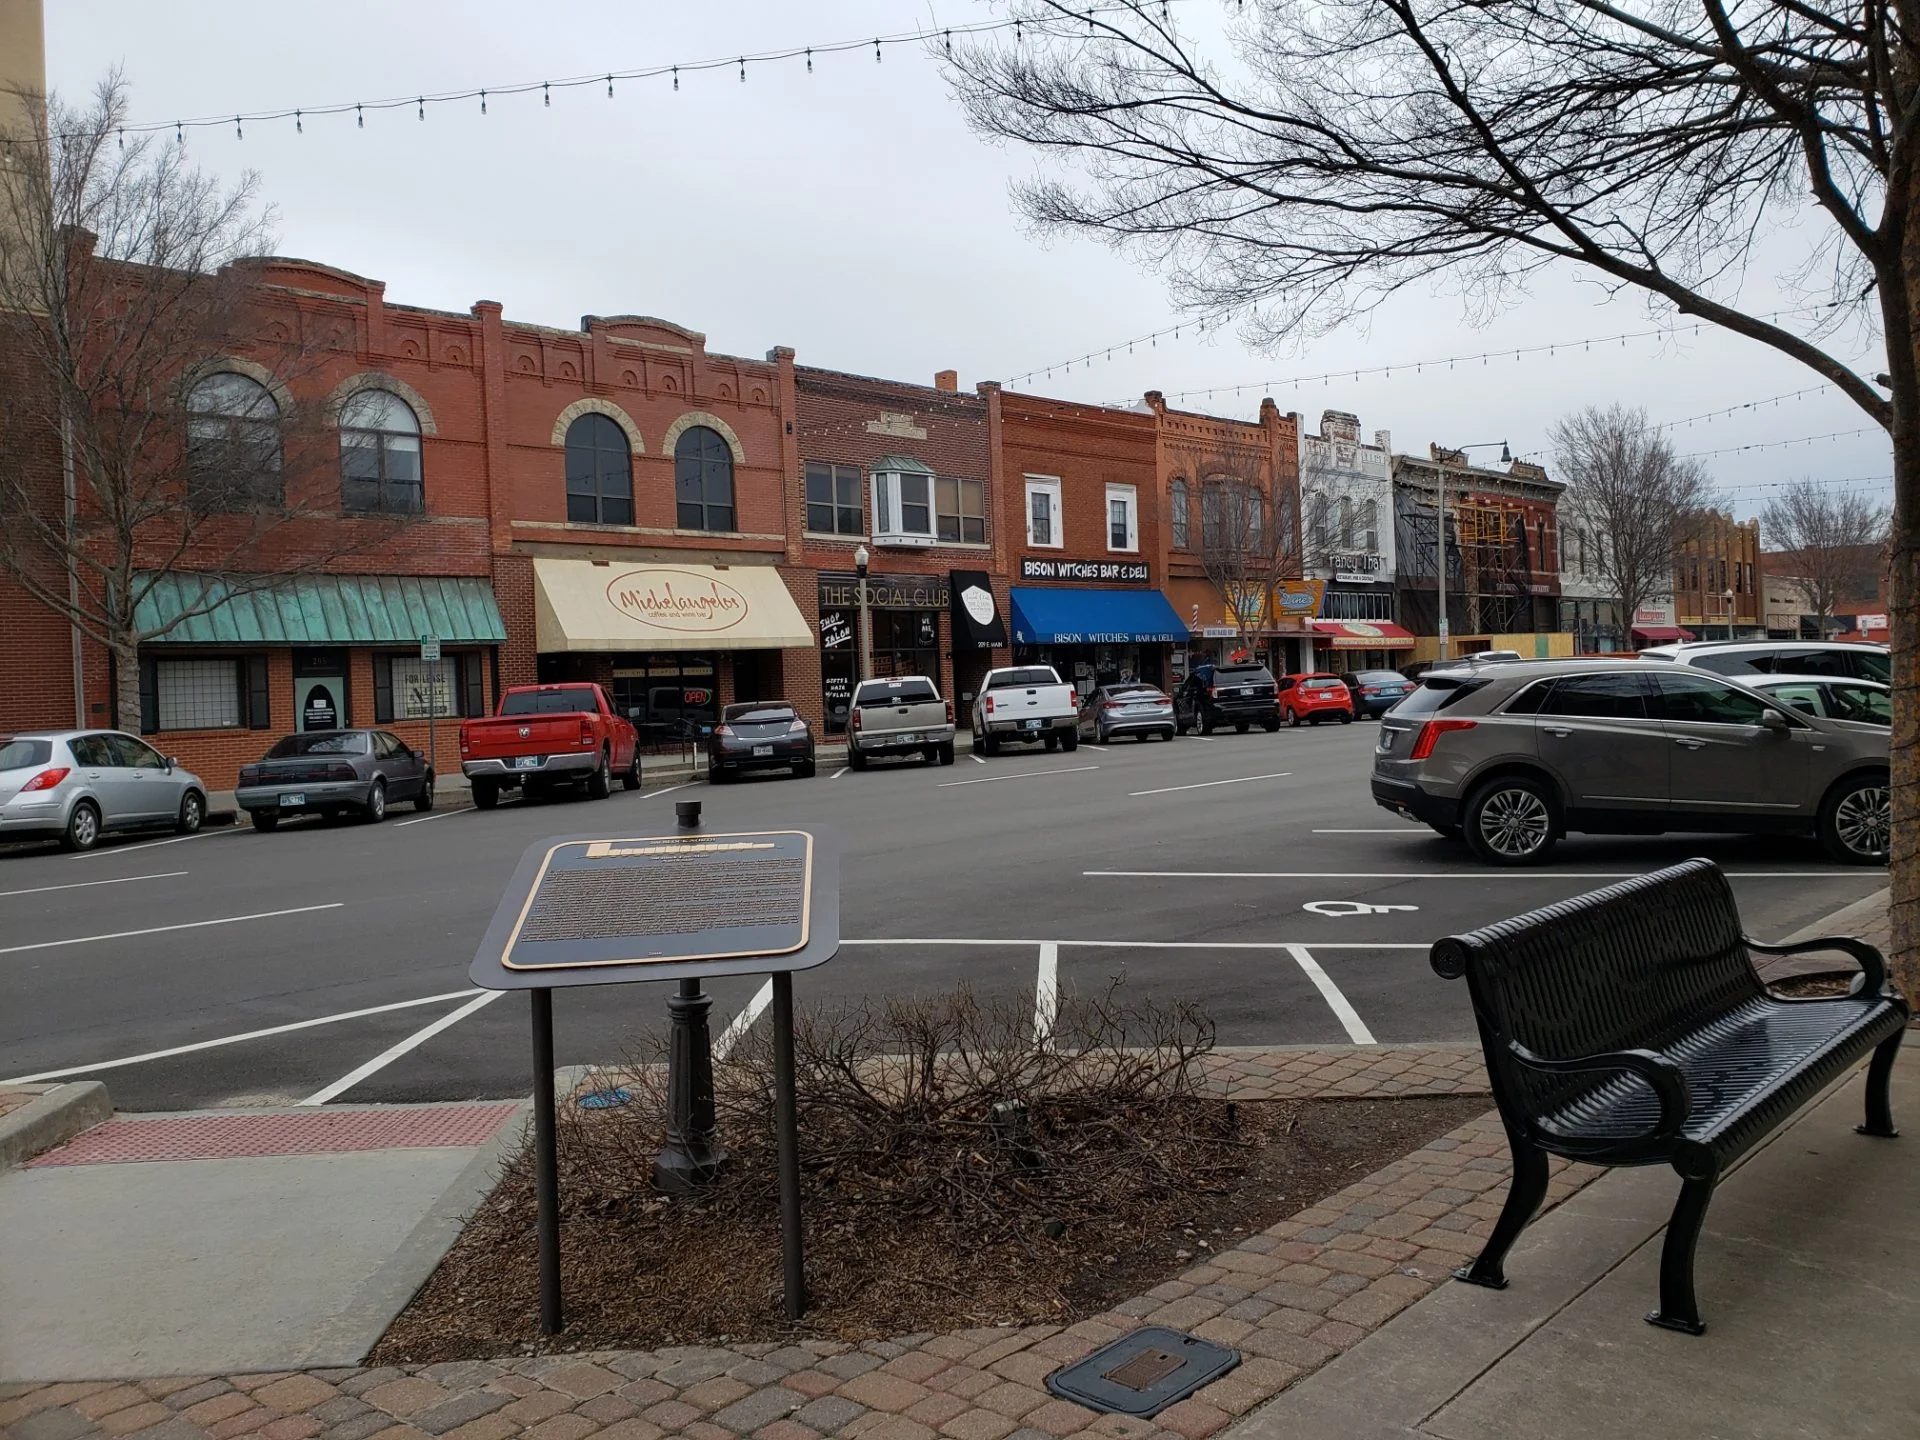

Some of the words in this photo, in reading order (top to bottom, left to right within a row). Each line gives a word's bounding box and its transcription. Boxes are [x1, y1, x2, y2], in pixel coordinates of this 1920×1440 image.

[1024, 561, 1055, 576] BISON
[1057, 562, 1099, 578] WITCHES
[1100, 564, 1119, 578] BAR
[1129, 566, 1147, 579] DELI
[822, 586, 851, 606] THE
[854, 586, 910, 607] SOCIAL
[913, 587, 950, 607] CLUB
[819, 612, 840, 628] SHOP
[922, 617, 930, 625] WE
[825, 626, 851, 645] SALON
[1054, 633, 1082, 643] BISON
[1088, 633, 1129, 643] WITCHES
[1135, 634, 1150, 642] BAR
[1151, 634, 1157, 642] &
[1158, 634, 1174, 642] DELI
[405, 674, 419, 684] FOR
[684, 691, 707, 703] OPEN
